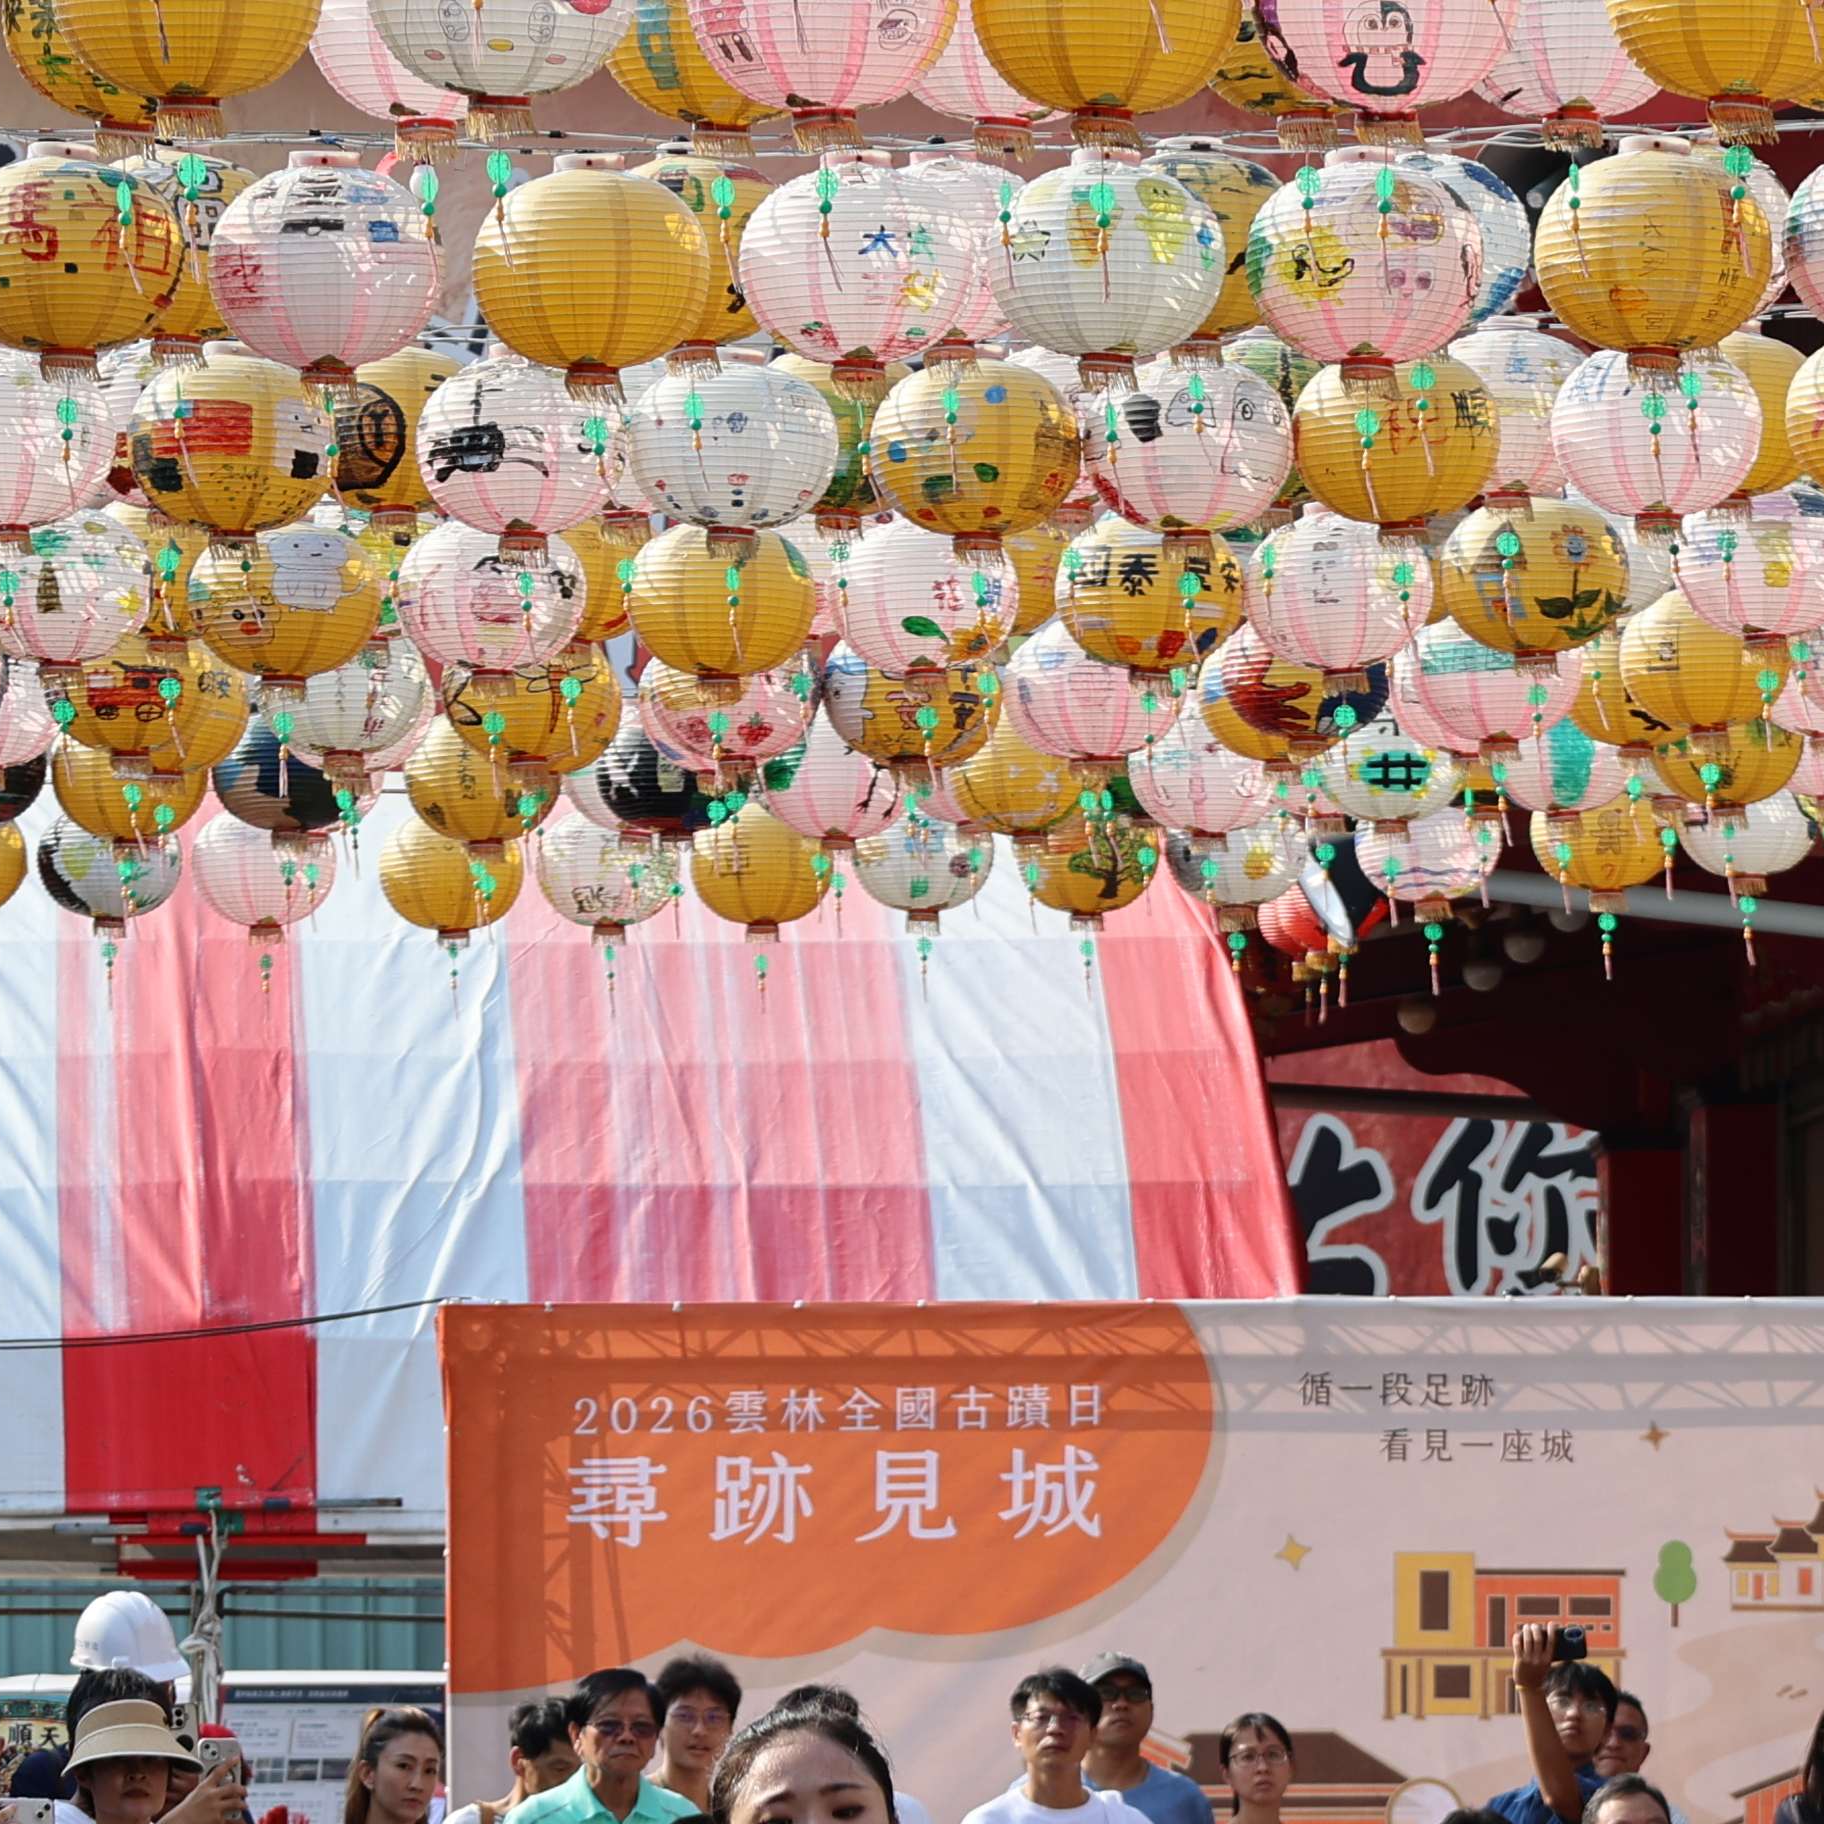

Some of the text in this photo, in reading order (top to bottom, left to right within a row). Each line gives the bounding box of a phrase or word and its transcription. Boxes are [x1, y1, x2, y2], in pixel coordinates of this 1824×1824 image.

[574, 1384, 1102, 1435] 2026雲林全國古蹟日
[1298, 1370, 1495, 1408] 循一段足跡
[1379, 1428, 1575, 1463] 看見一座城
[565, 1443, 1102, 1548] 尋跡見城
